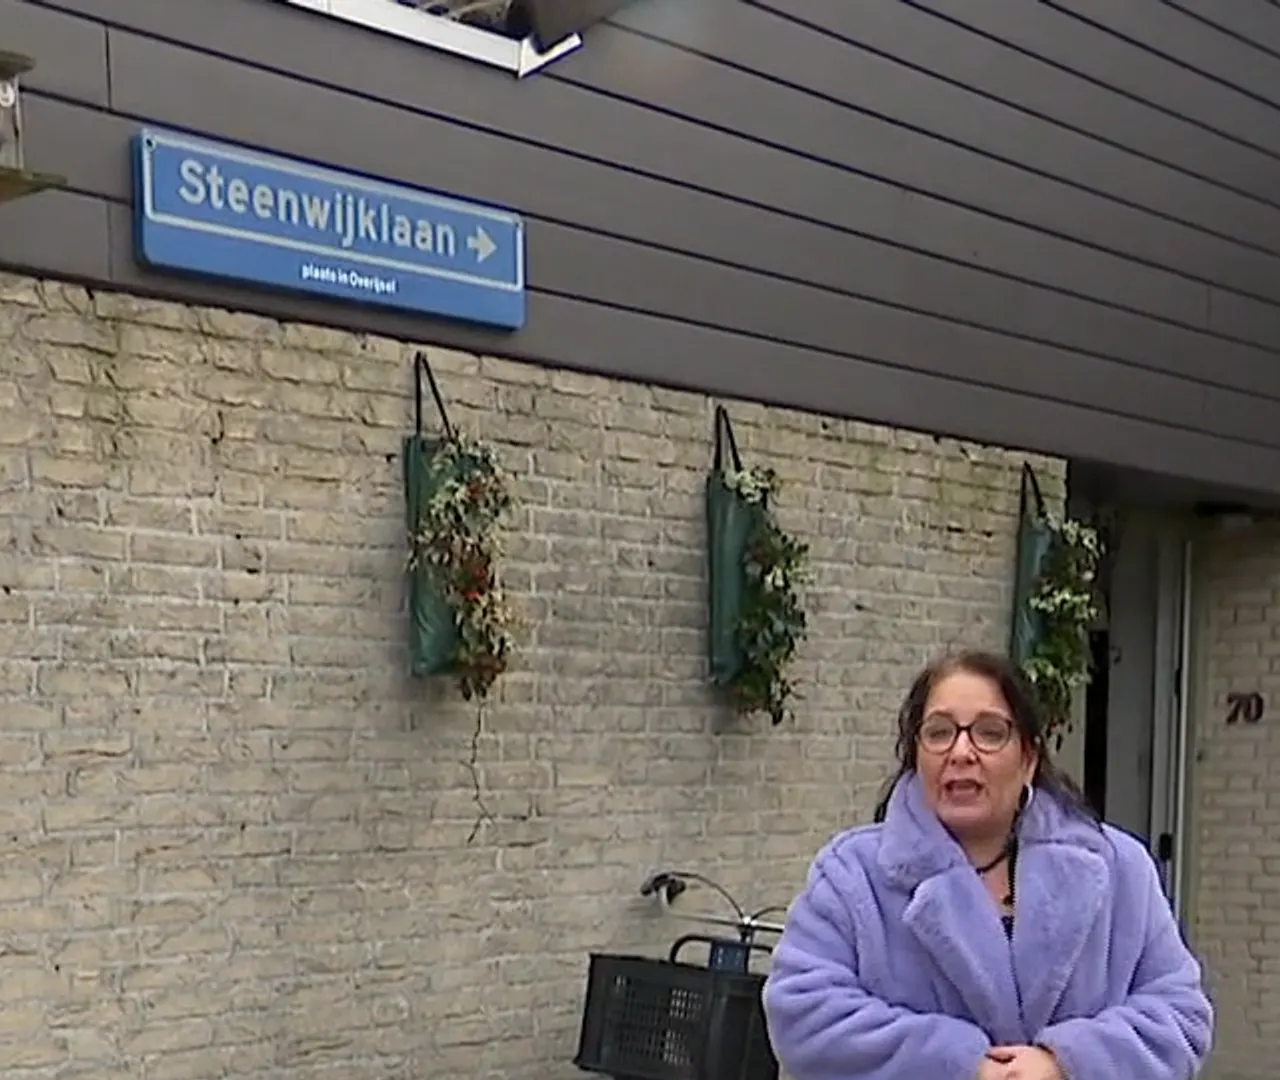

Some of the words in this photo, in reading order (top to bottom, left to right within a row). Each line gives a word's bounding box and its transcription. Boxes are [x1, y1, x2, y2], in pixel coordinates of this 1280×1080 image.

[178, 158, 456, 257] Steenwijklaan
[302, 263, 336, 284] plaats
[338, 268, 348, 284] in
[1226, 691, 1264, 725] 70
